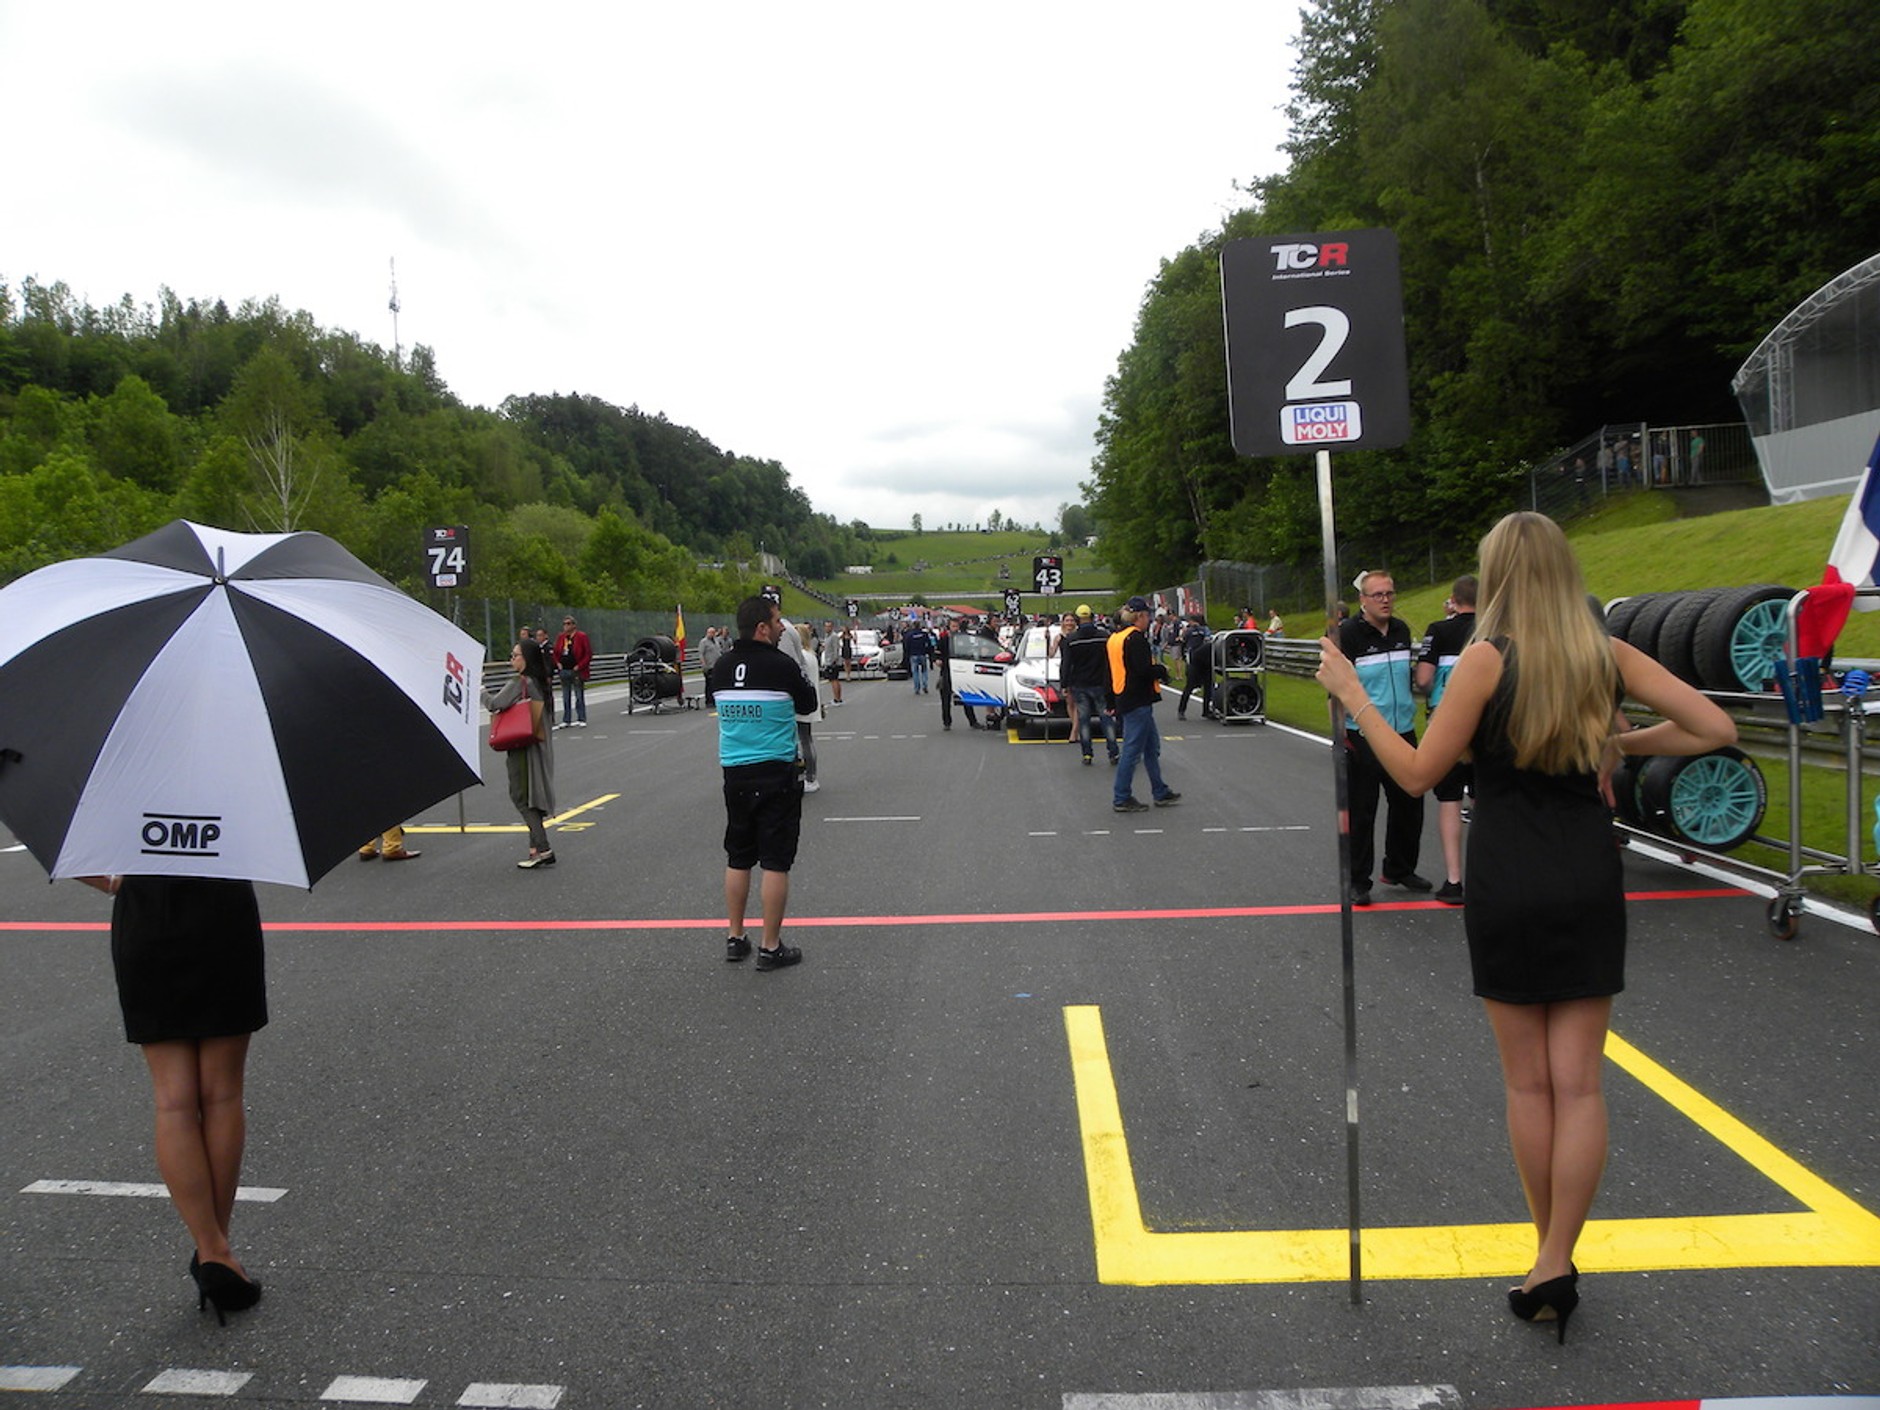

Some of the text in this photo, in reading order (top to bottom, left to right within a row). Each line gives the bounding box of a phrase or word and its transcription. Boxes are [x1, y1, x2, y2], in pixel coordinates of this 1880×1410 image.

[1270, 243, 1349, 271] TCR
[1284, 305, 1352, 401] 2
[1296, 406, 1345, 423] LIQUI
[1297, 423, 1346, 439] MOLY
[428, 547, 466, 574] 74
[1036, 569, 1061, 586] 43
[443, 651, 464, 714] TCR
[142, 820, 221, 849] OMP
